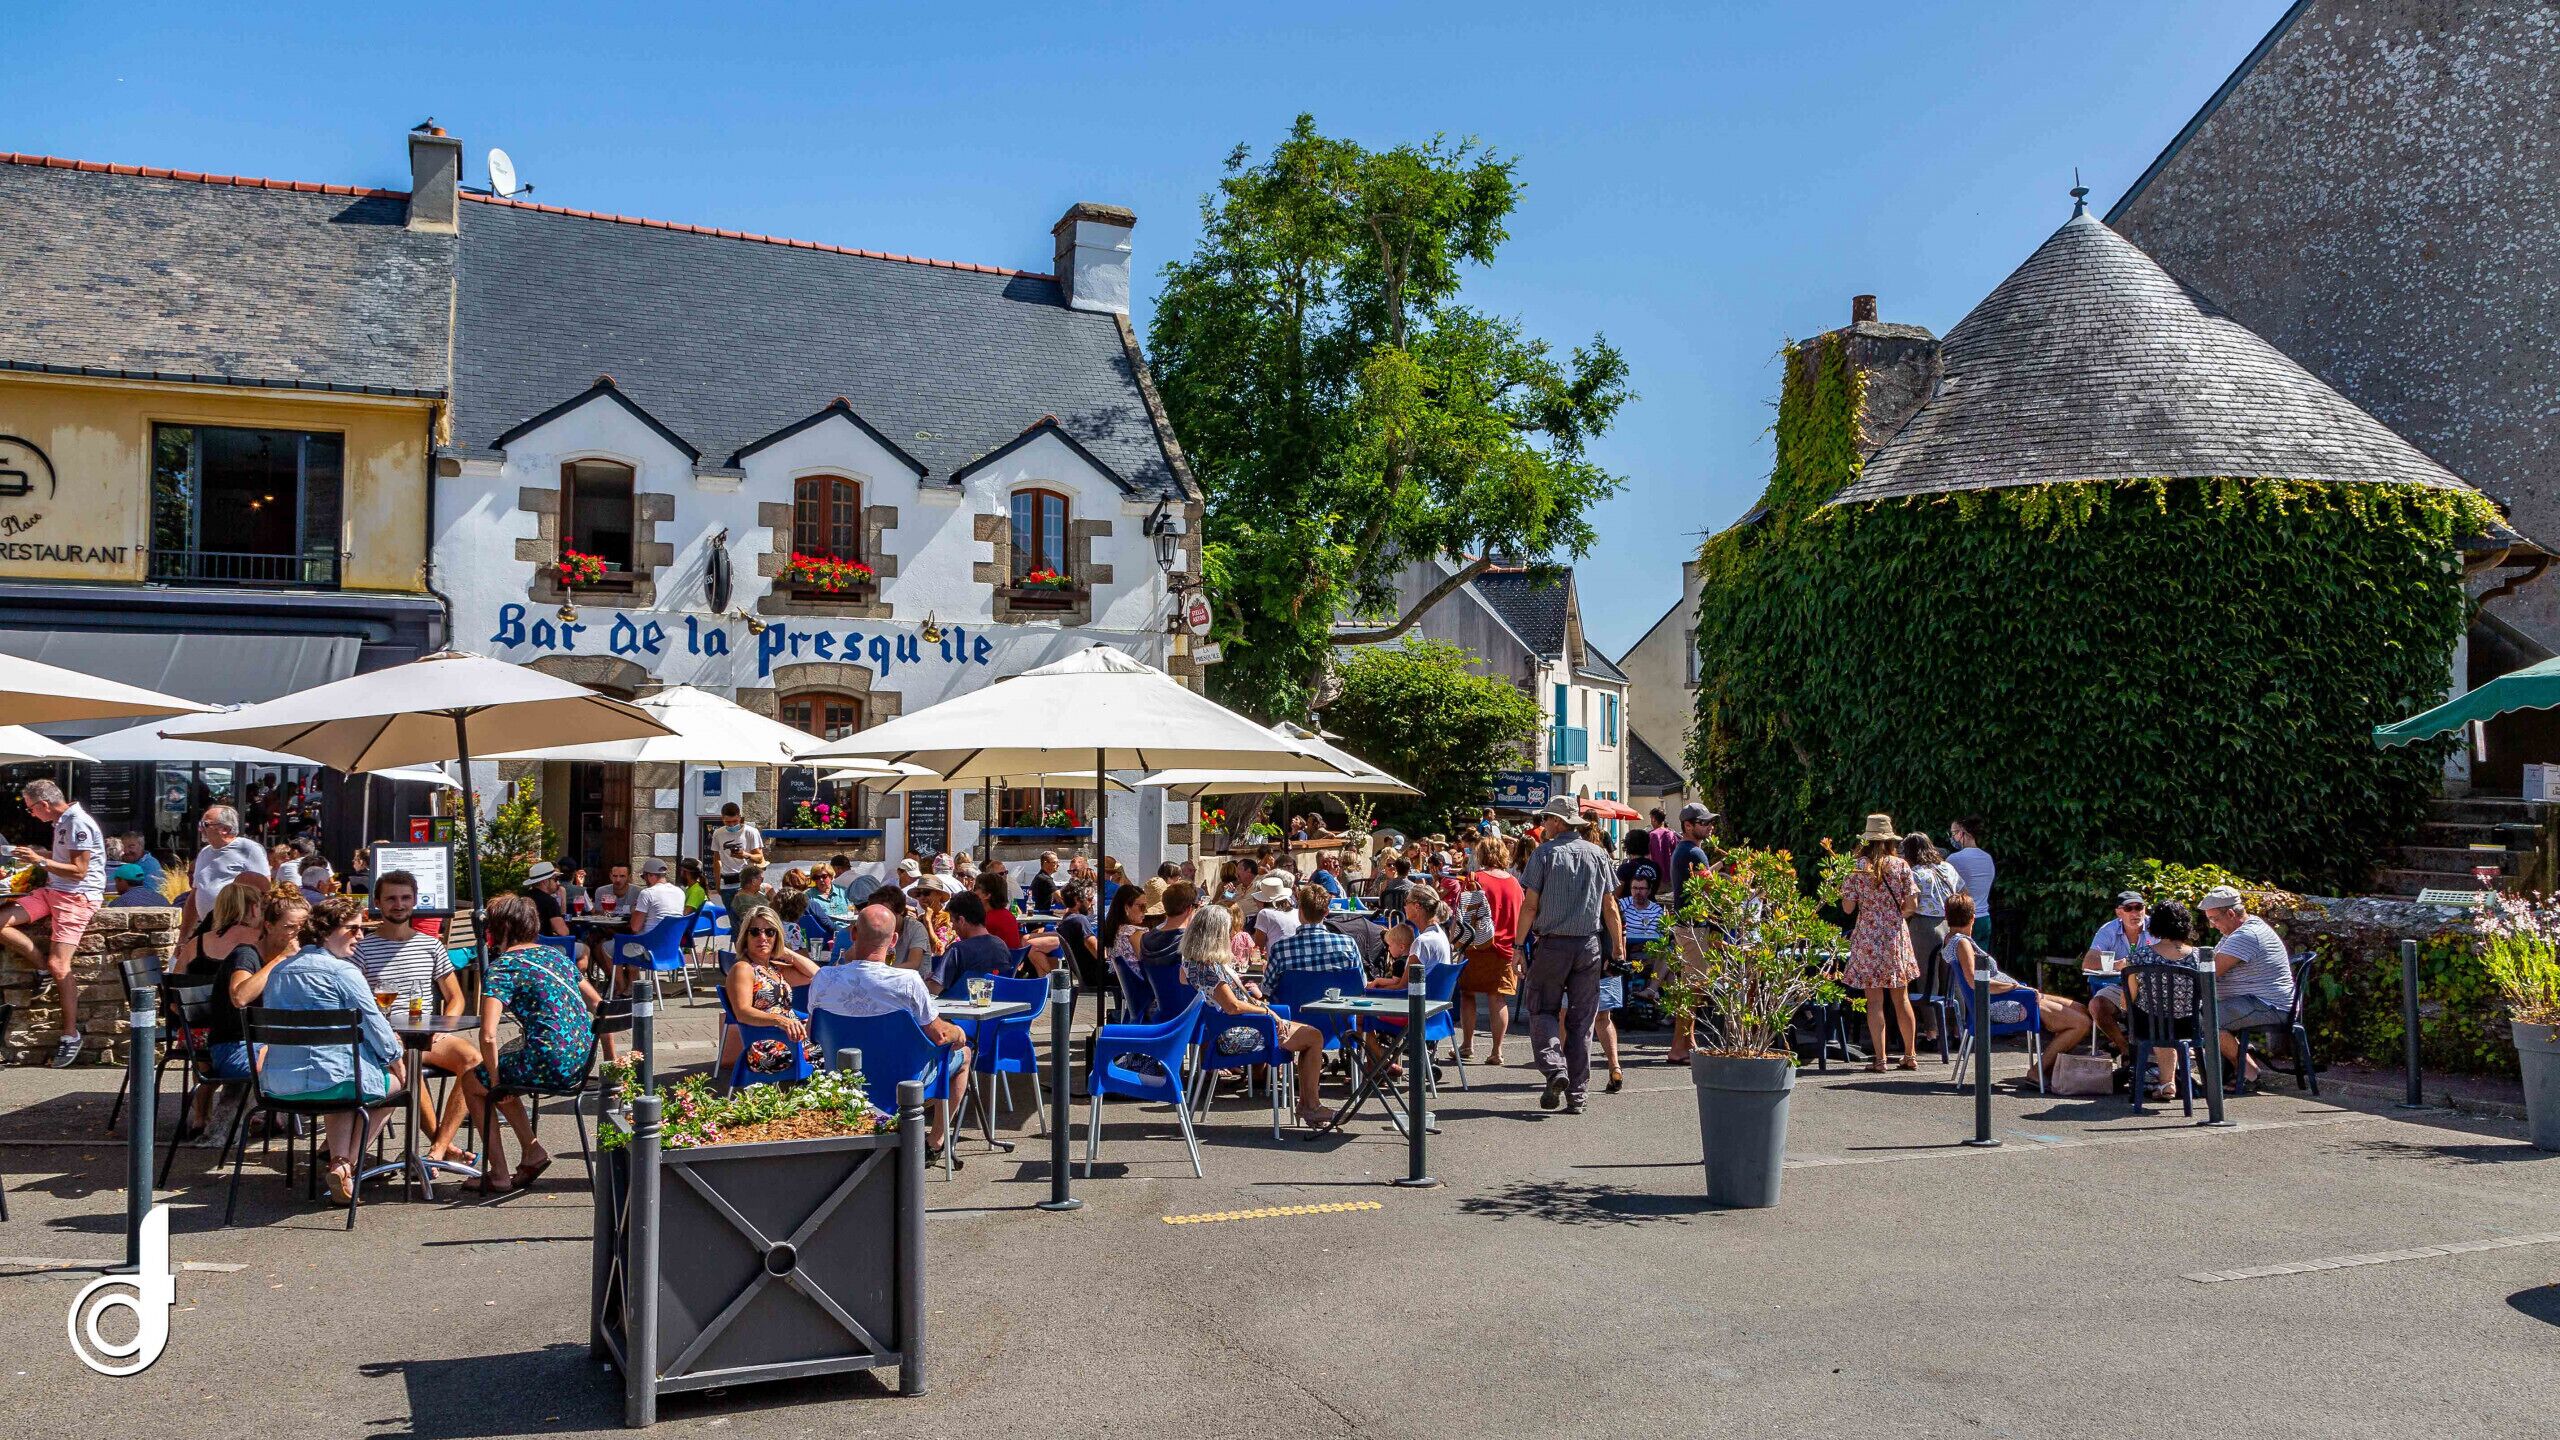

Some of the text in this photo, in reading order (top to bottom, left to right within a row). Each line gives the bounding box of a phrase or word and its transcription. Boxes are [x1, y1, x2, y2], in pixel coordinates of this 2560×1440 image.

[1, 513, 42, 536] Place
[0, 542, 128, 563] RESTAURANT
[490, 603, 587, 652] Bar
[610, 612, 665, 656] de
[684, 615, 730, 657] la
